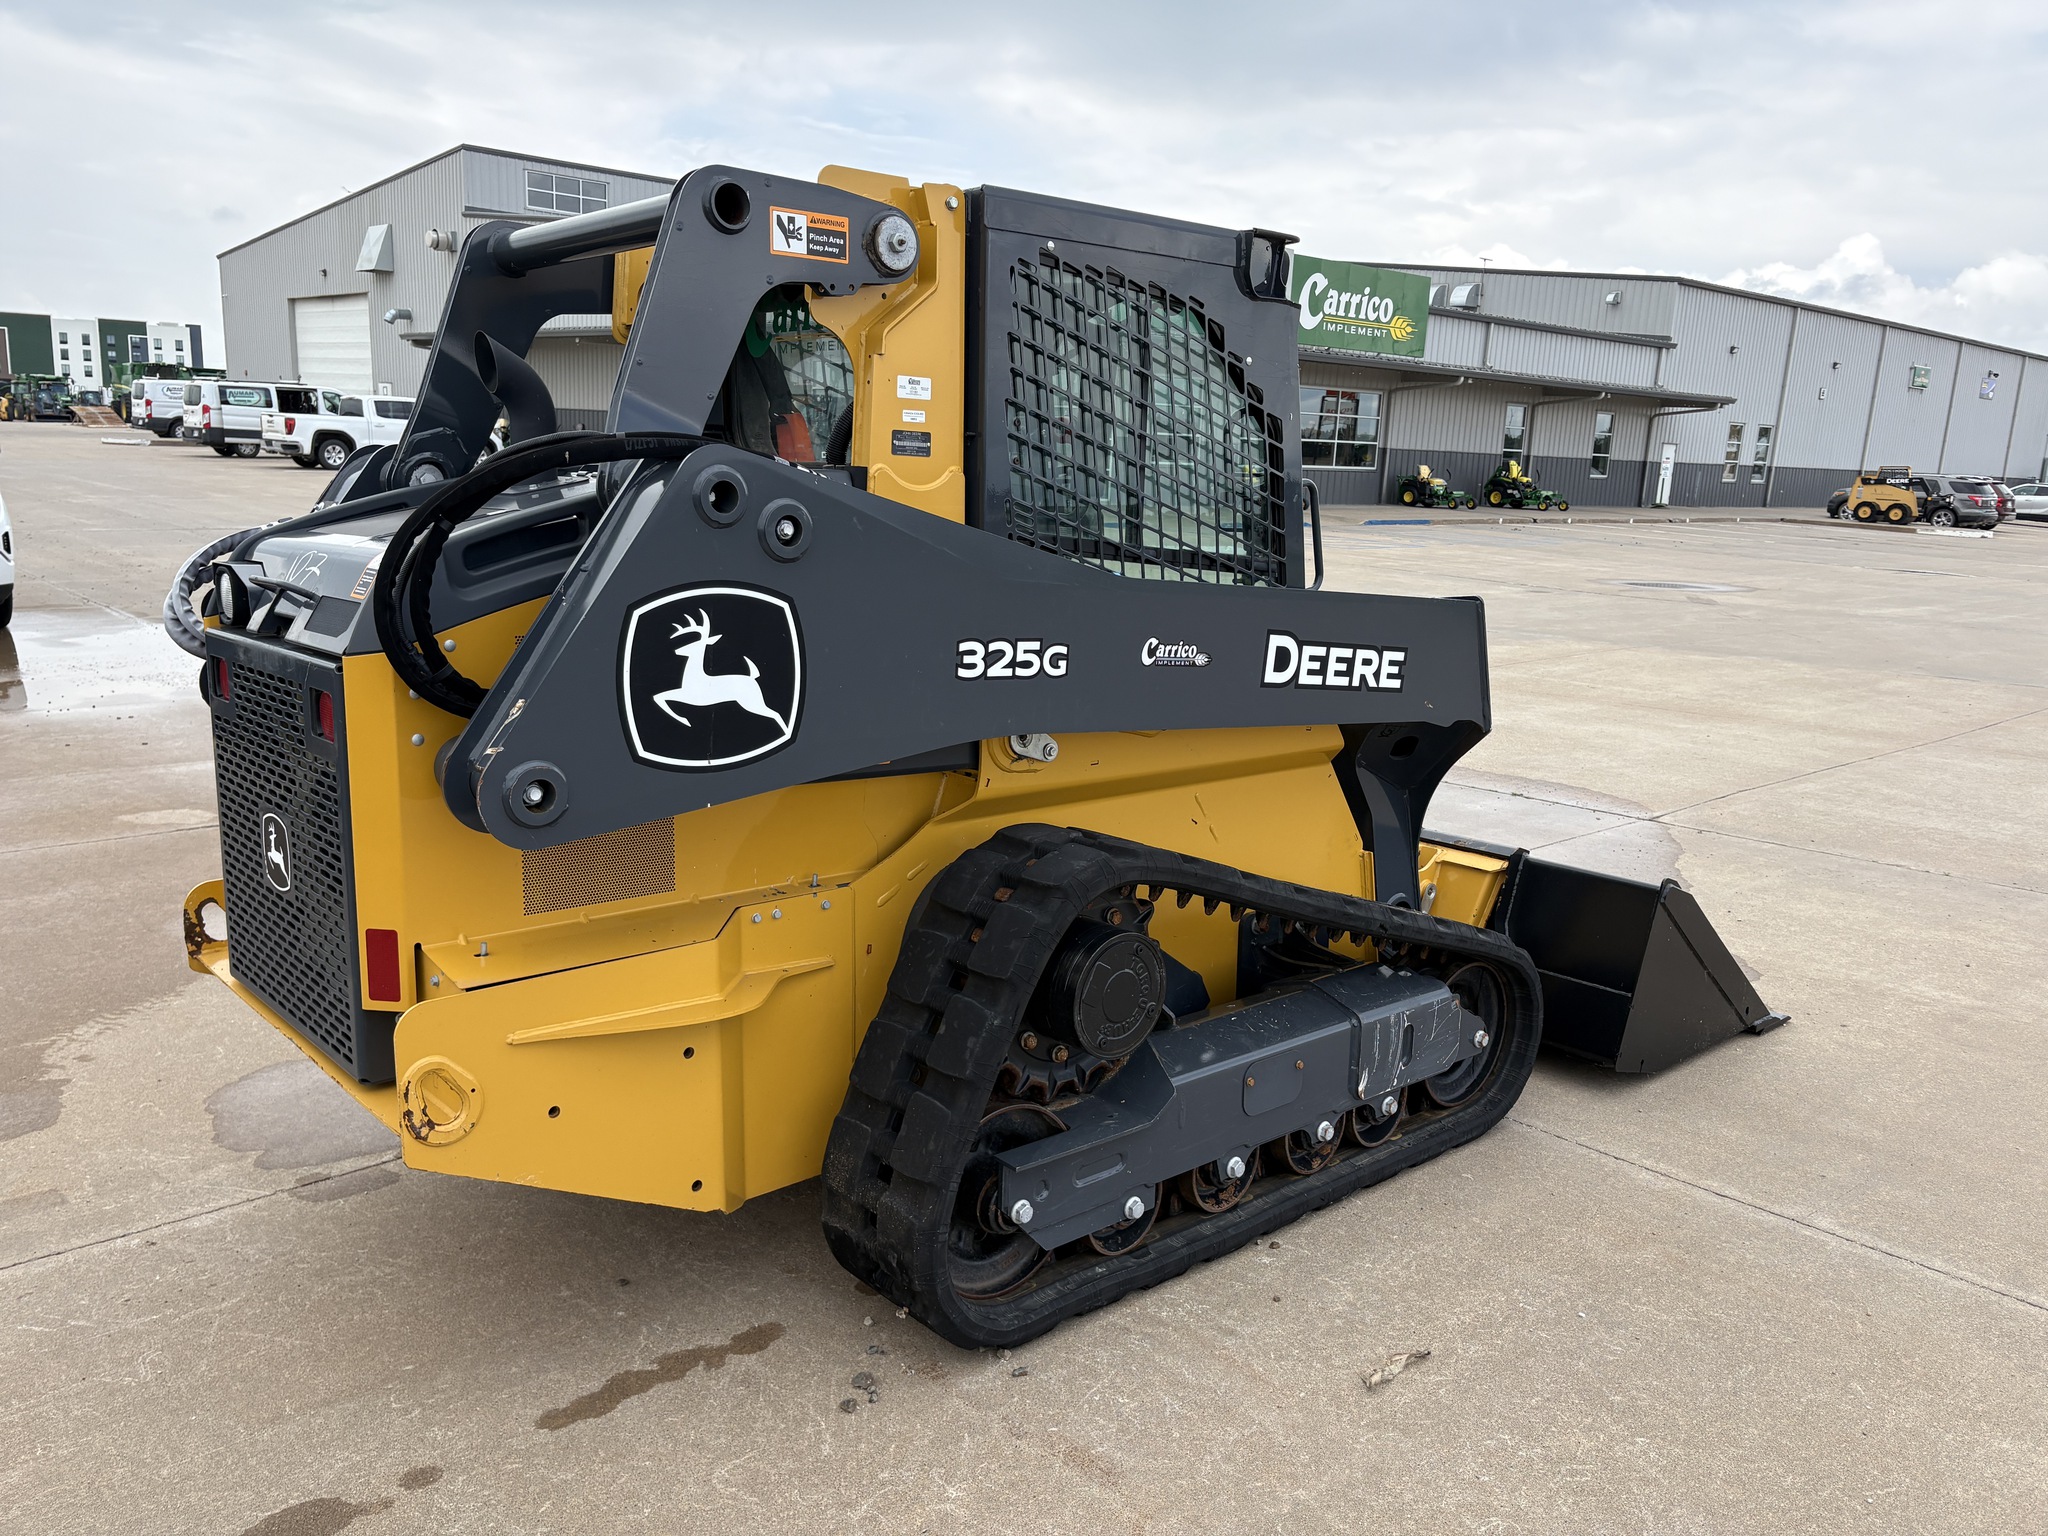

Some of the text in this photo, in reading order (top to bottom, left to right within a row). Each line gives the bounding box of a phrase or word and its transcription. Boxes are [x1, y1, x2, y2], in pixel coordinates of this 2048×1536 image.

[816, 217, 846, 229] WARNING
[809, 233, 844, 245] Pinch Area
[809, 243, 840, 255] Keep Away
[1298, 272, 1394, 330] Carrico
[1323, 322, 1388, 338] IMPLEMENT
[957, 640, 1069, 679] 325G
[1141, 637, 1197, 666] Carrico
[1263, 633, 1405, 689] DEERE
